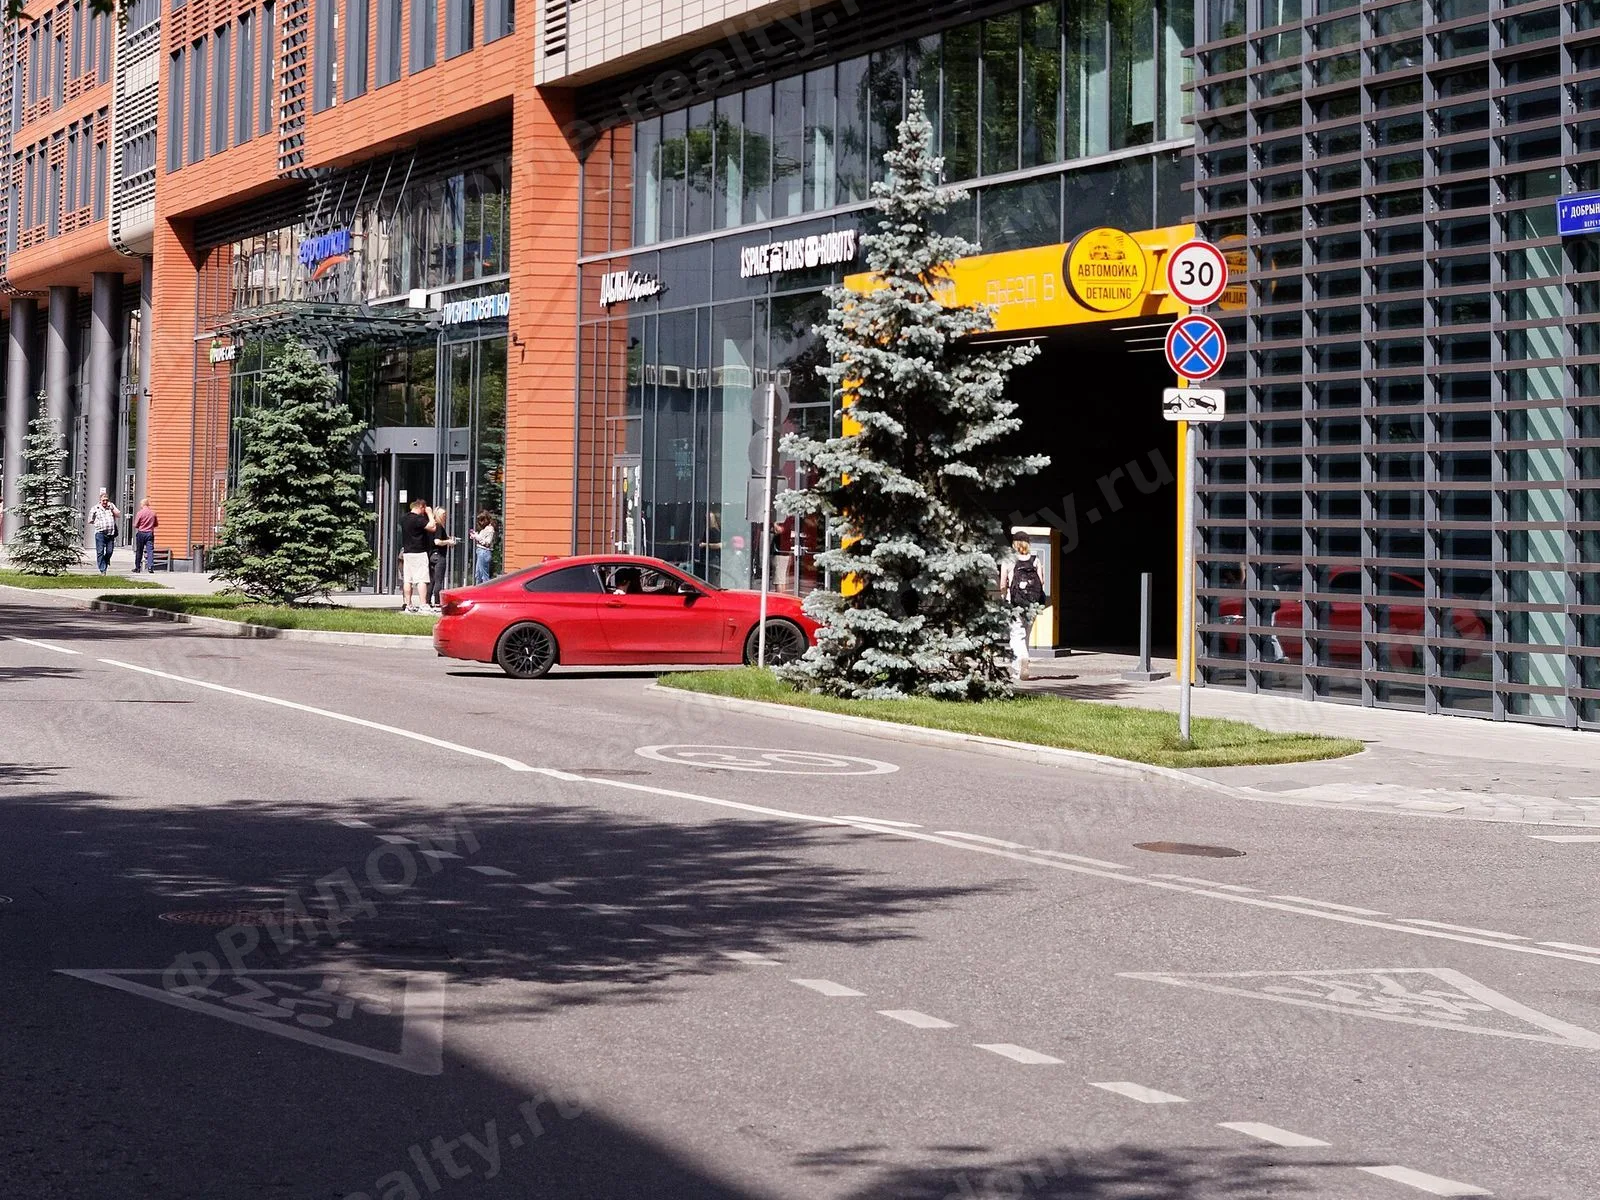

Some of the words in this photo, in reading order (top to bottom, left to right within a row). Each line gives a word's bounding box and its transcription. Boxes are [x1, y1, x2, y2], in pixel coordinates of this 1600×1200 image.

[745, 244, 770, 278] SPACE
[783, 238, 804, 271] CARS
[820, 229, 855, 265] ROBOTS
[1077, 261, 1138, 278] АВТОМОЙКА
[1180, 260, 1214, 287] 30
[1086, 286, 1132, 300] DETAILING
